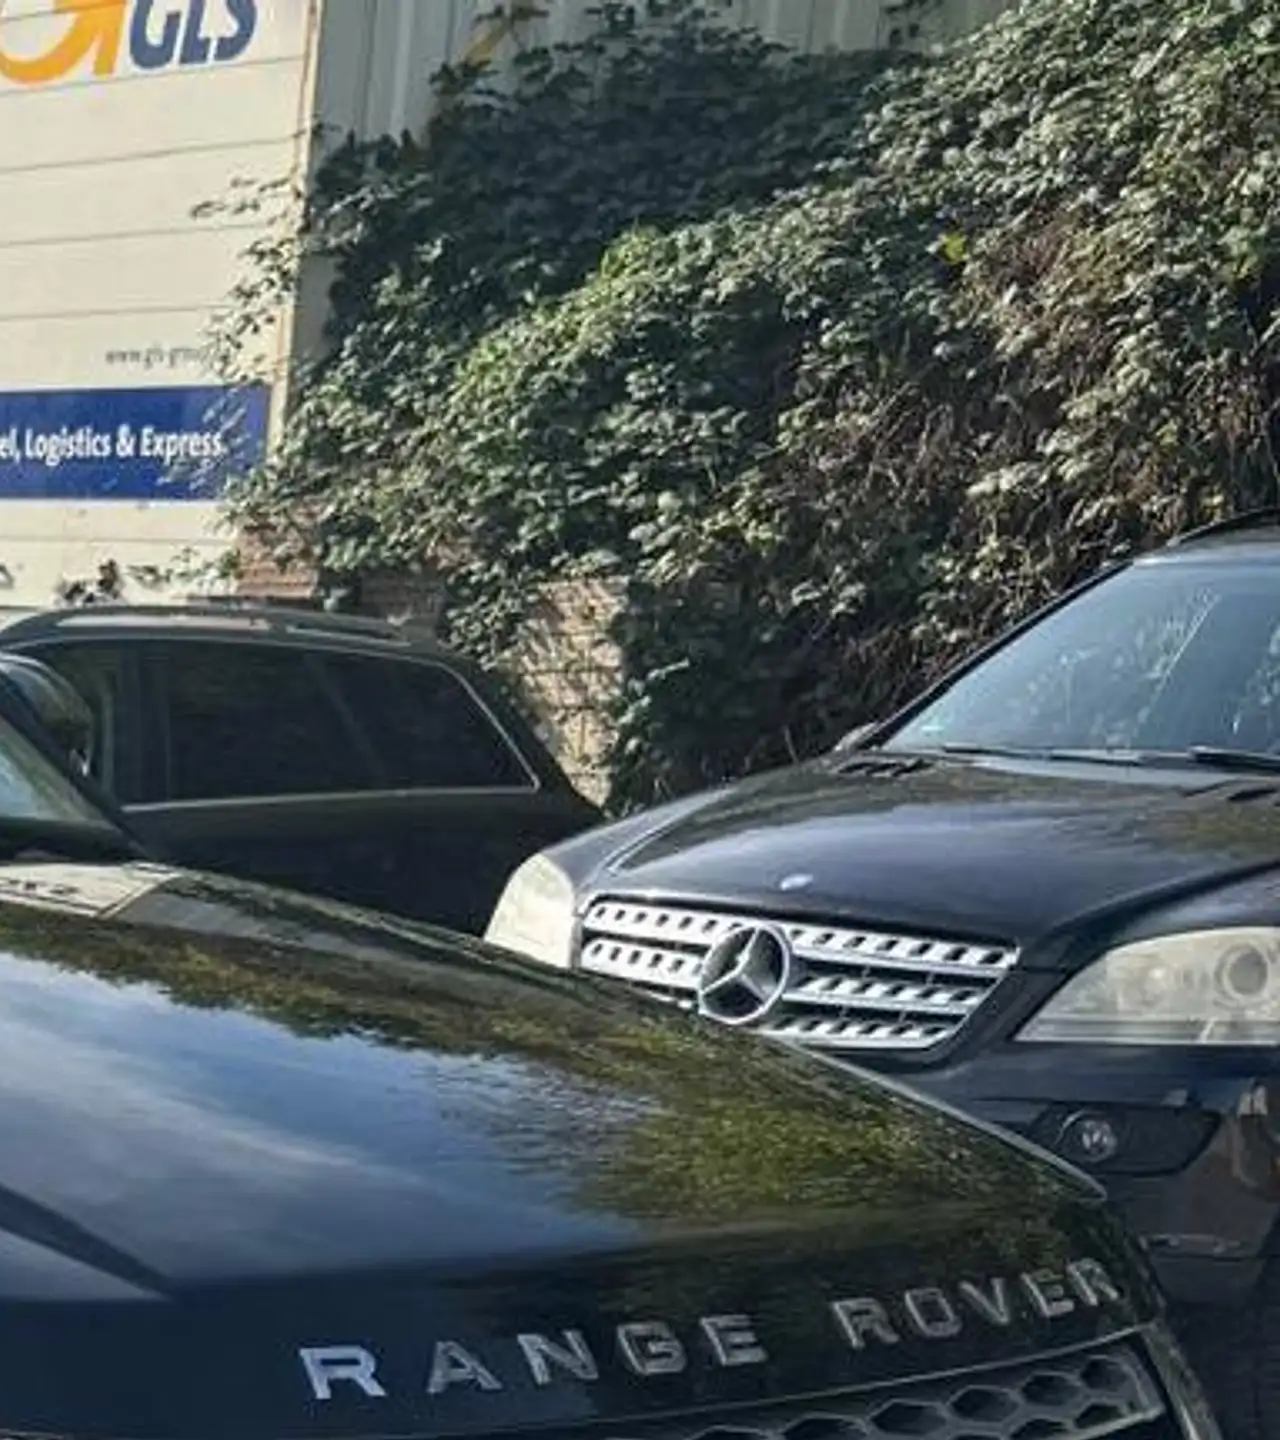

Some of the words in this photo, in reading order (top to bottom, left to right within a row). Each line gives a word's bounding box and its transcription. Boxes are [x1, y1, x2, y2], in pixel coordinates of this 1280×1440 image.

[130, 0, 257, 69] GLS
[25, 424, 111, 467] Logistics
[116, 423, 136, 456] &
[299, 1314, 768, 1400] RANGE
[832, 1256, 1127, 1351] ROVER
